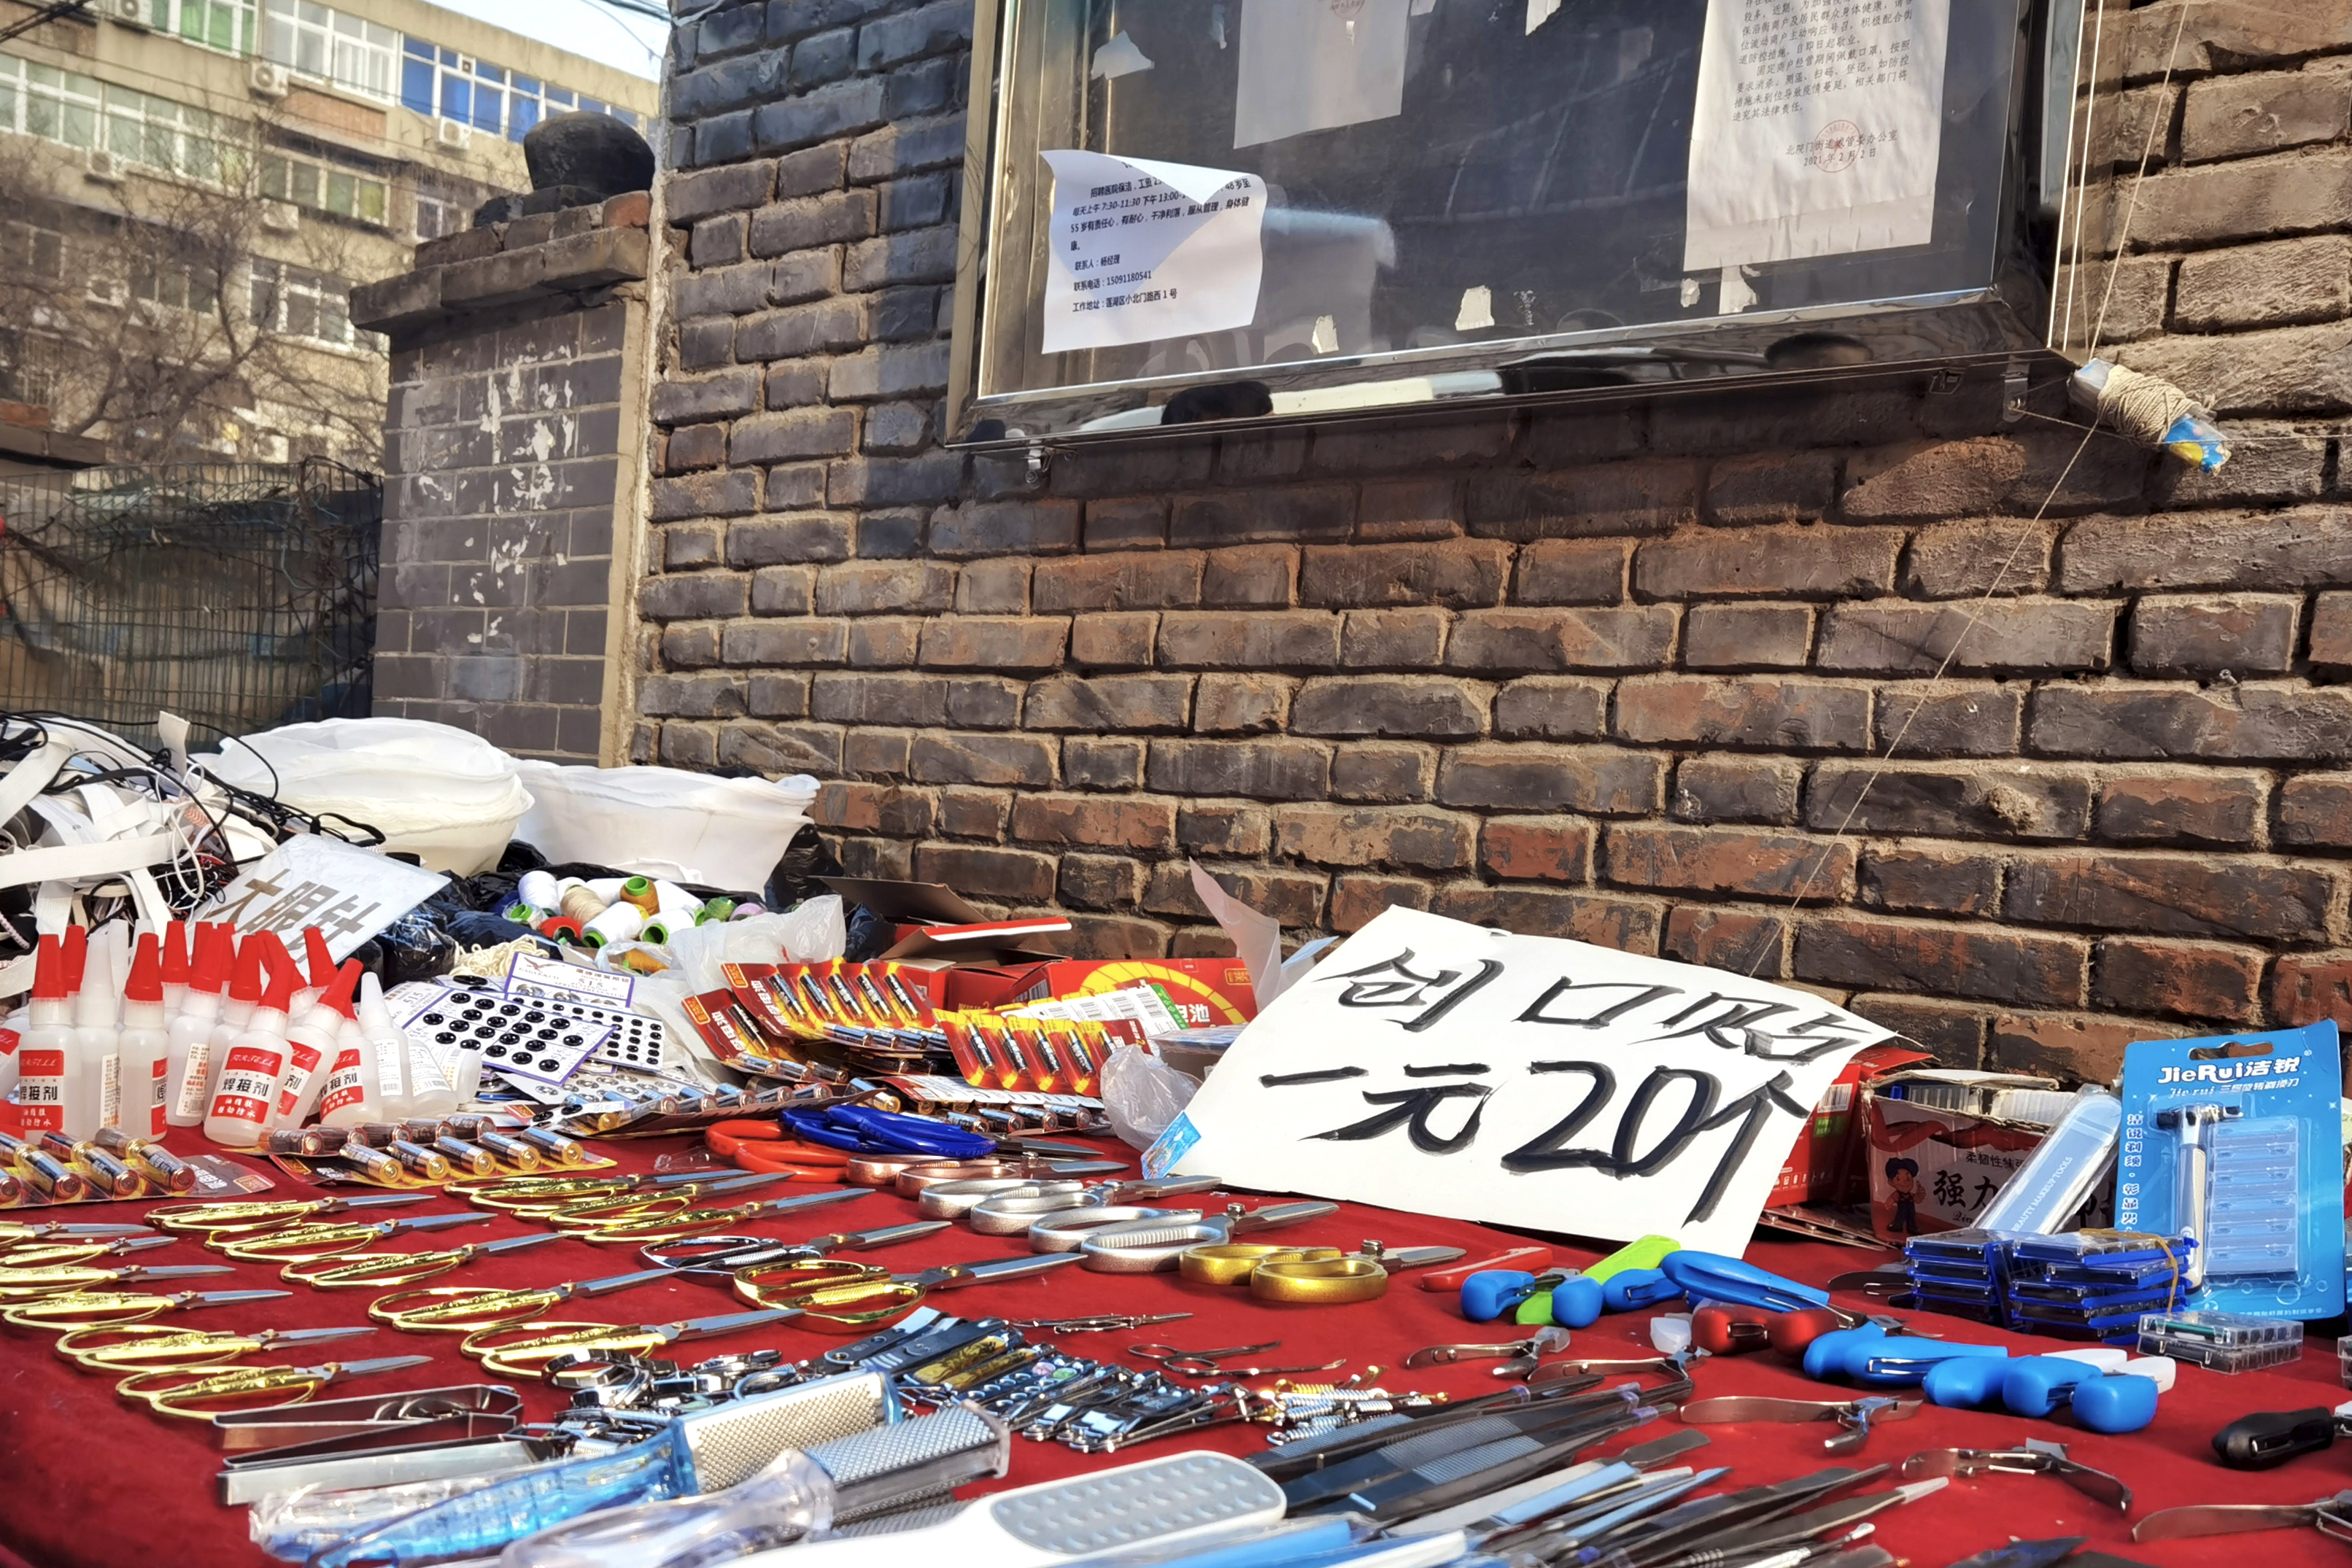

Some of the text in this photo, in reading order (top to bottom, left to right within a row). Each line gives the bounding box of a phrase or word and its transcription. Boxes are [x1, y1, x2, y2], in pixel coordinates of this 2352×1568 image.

[222, 1078, 269, 1097] 焊接剂
[2011, 1157, 2073, 1233] BEAUTY MAKEUP TOOLS
